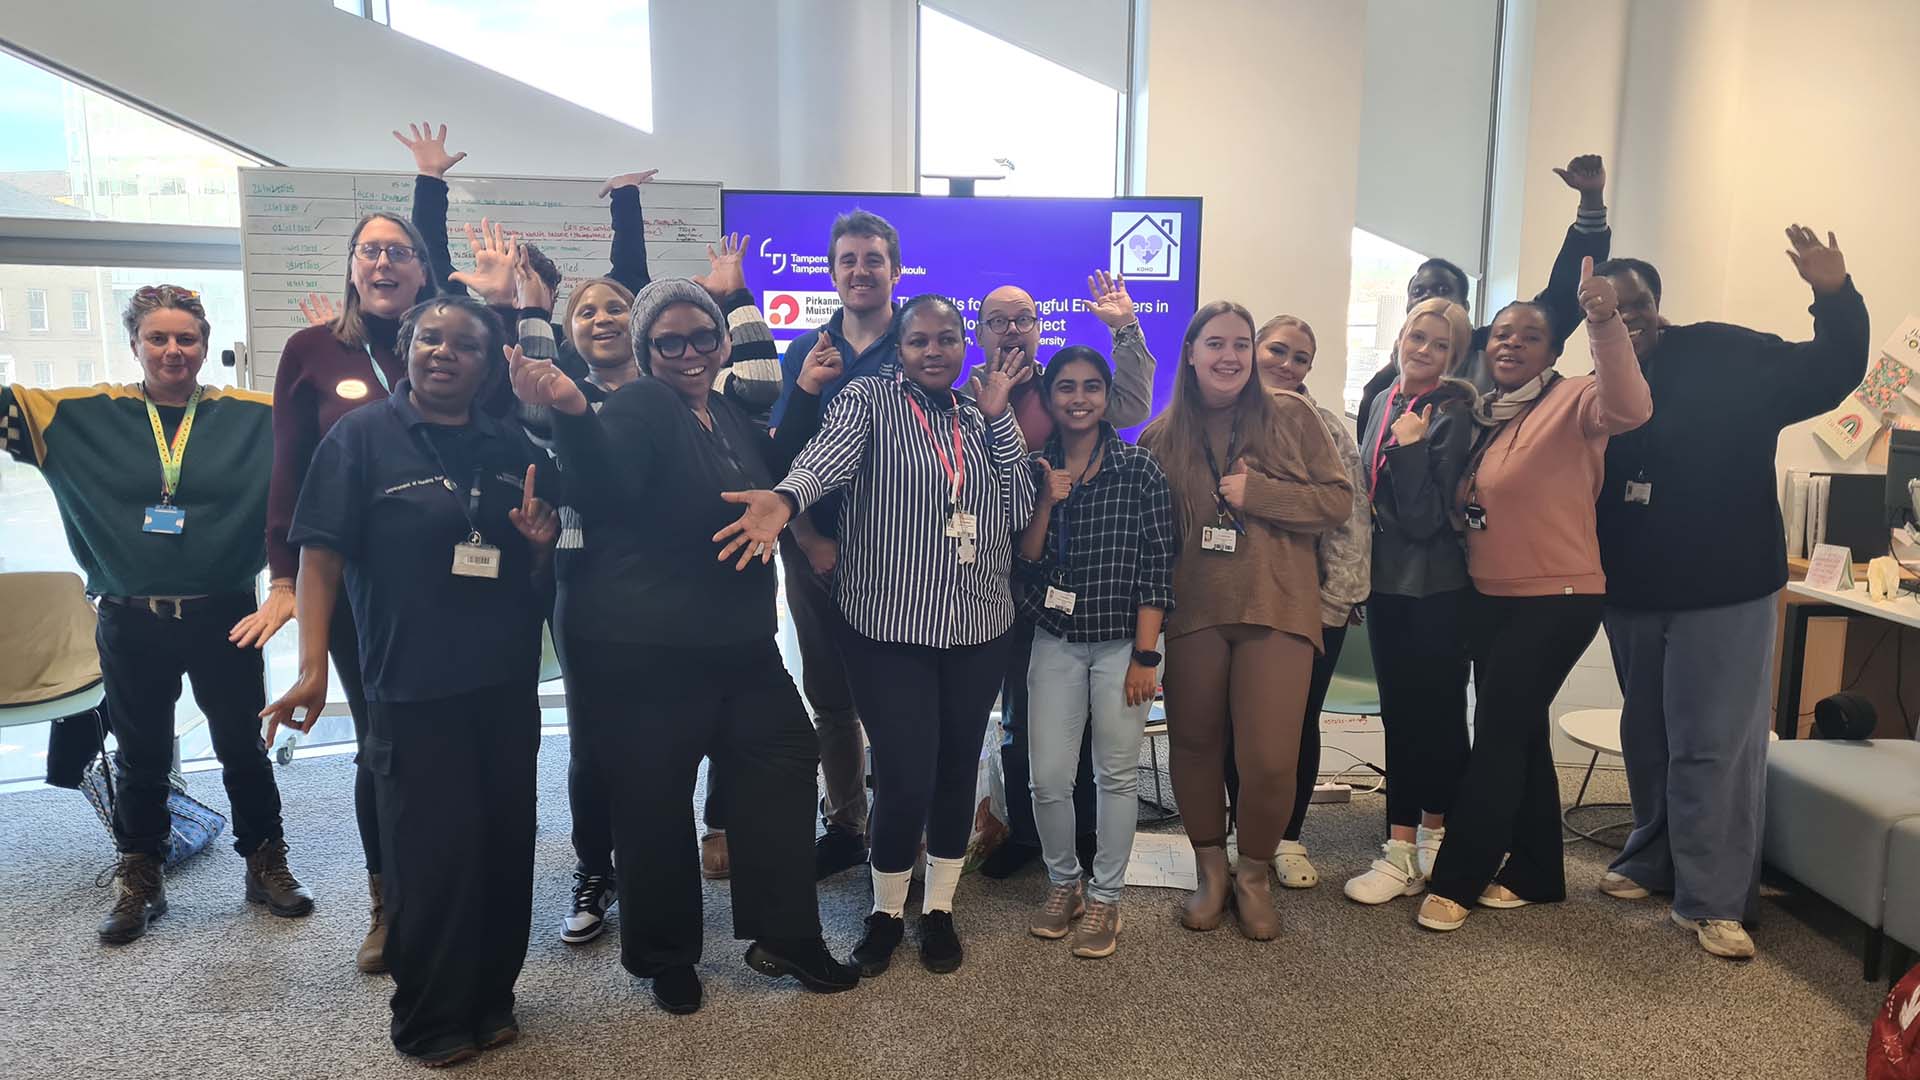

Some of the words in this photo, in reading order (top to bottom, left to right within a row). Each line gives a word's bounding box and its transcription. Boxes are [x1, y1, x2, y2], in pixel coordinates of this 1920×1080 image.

[791, 254, 829, 264] Tampere
[900, 265, 926, 275] koulu
[1156, 299, 1169, 313] in
[1039, 317, 1067, 334] ject
[1039, 336, 1066, 347] ersity
